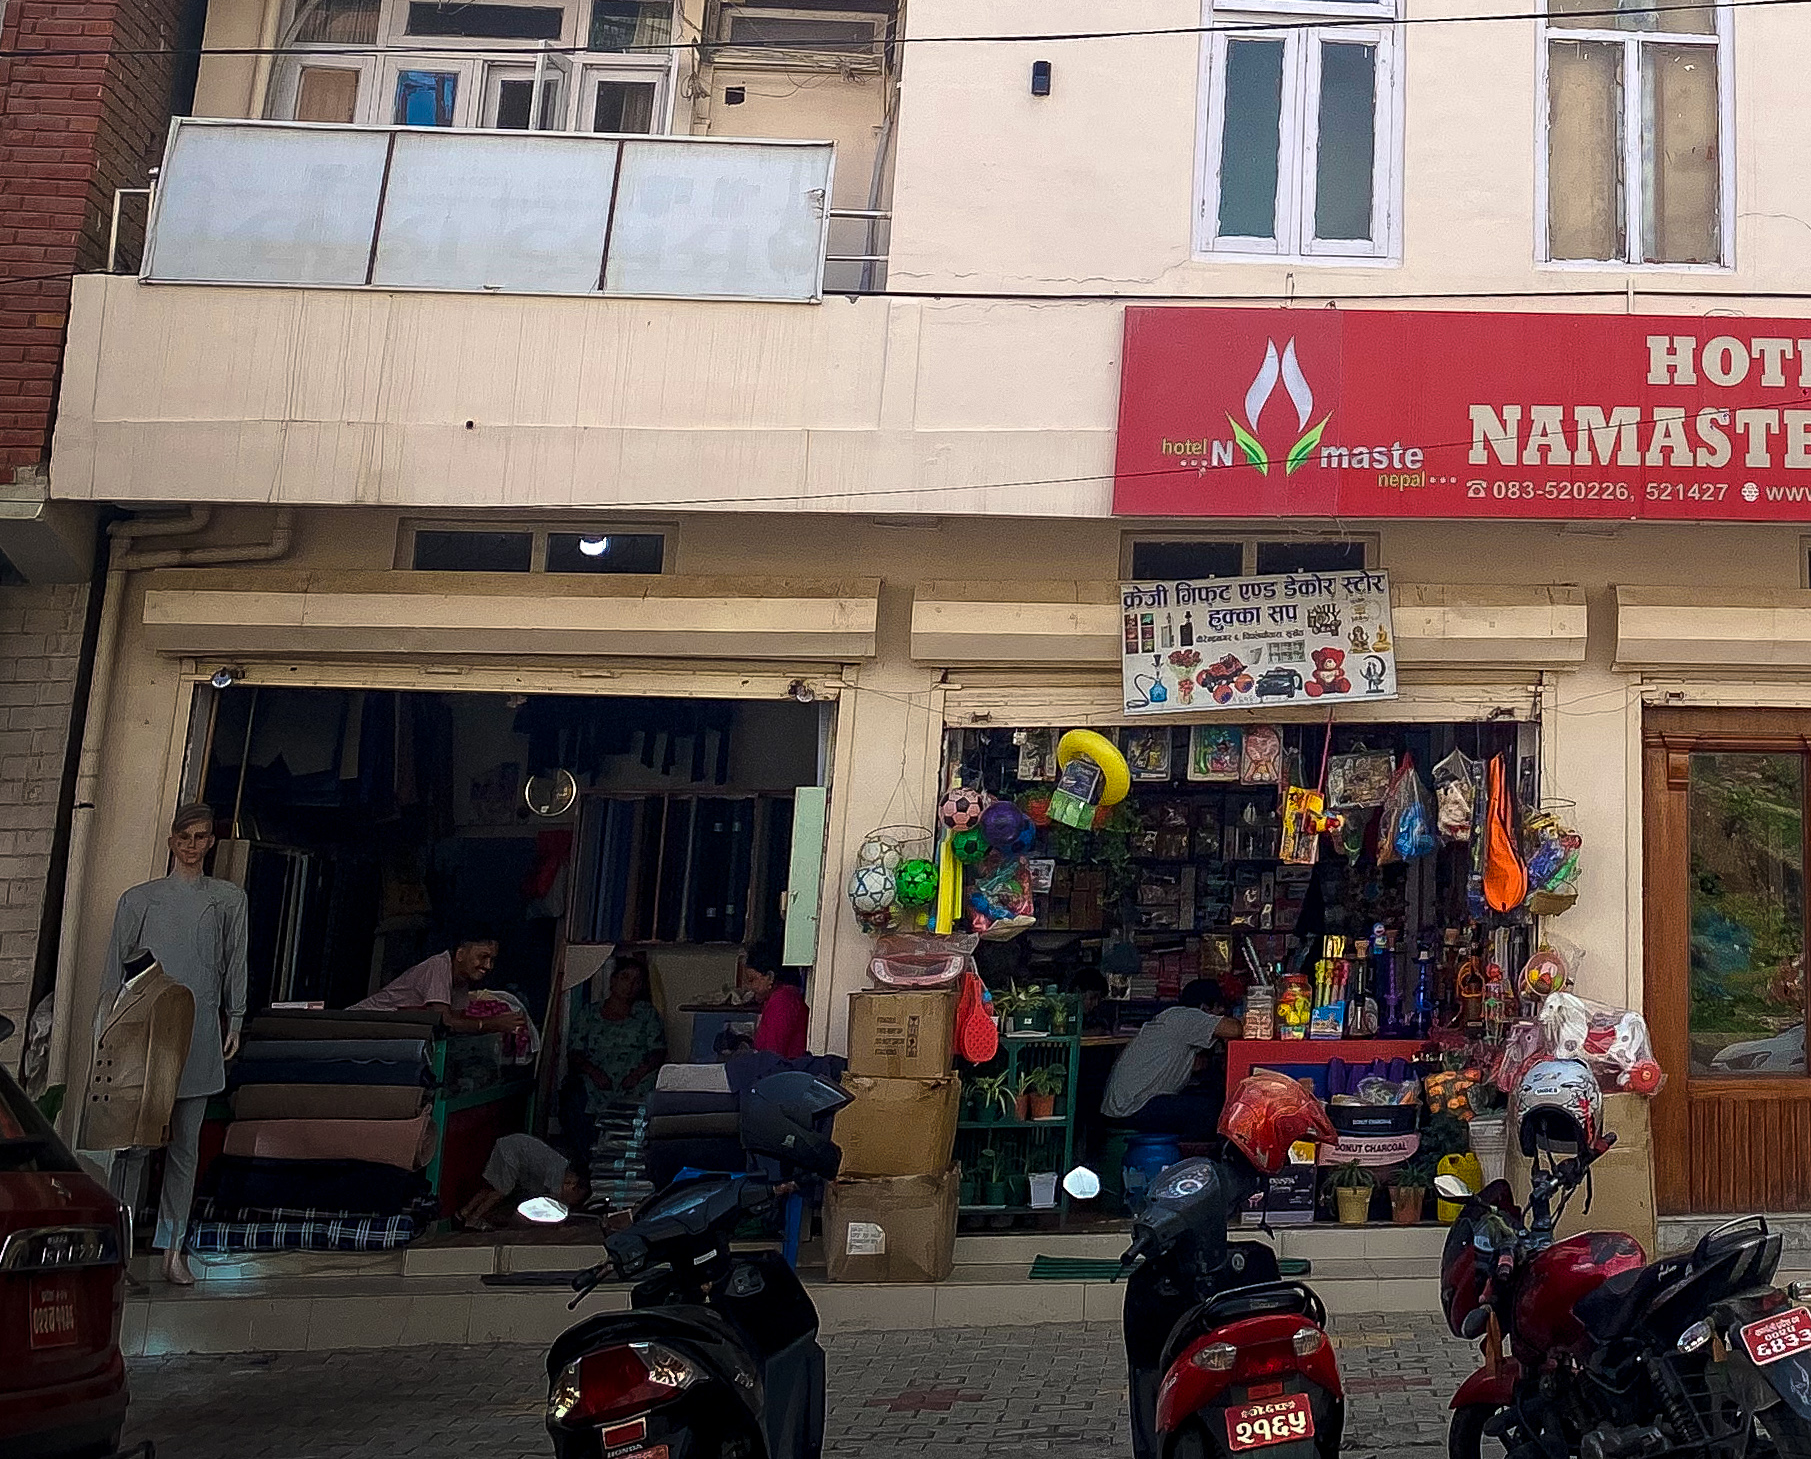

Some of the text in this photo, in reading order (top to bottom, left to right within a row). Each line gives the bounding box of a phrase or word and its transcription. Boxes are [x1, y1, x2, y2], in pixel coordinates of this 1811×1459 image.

[1161, 438, 1207, 456] hotel
[1493, 480, 1728, 502] 083-520226, 521427
[1123, 583, 1169, 612] क्रेजी
[1238, 579, 1277, 603] एण्ड
[1283, 574, 1336, 600] डेकोर
[1341, 573, 1387, 596] स्टोर
[1207, 603, 1261, 633] हुक्का
[1335, 1141, 1407, 1153] DONUT CHARCOAL
[1236, 1411, 1307, 1443] २१६५
